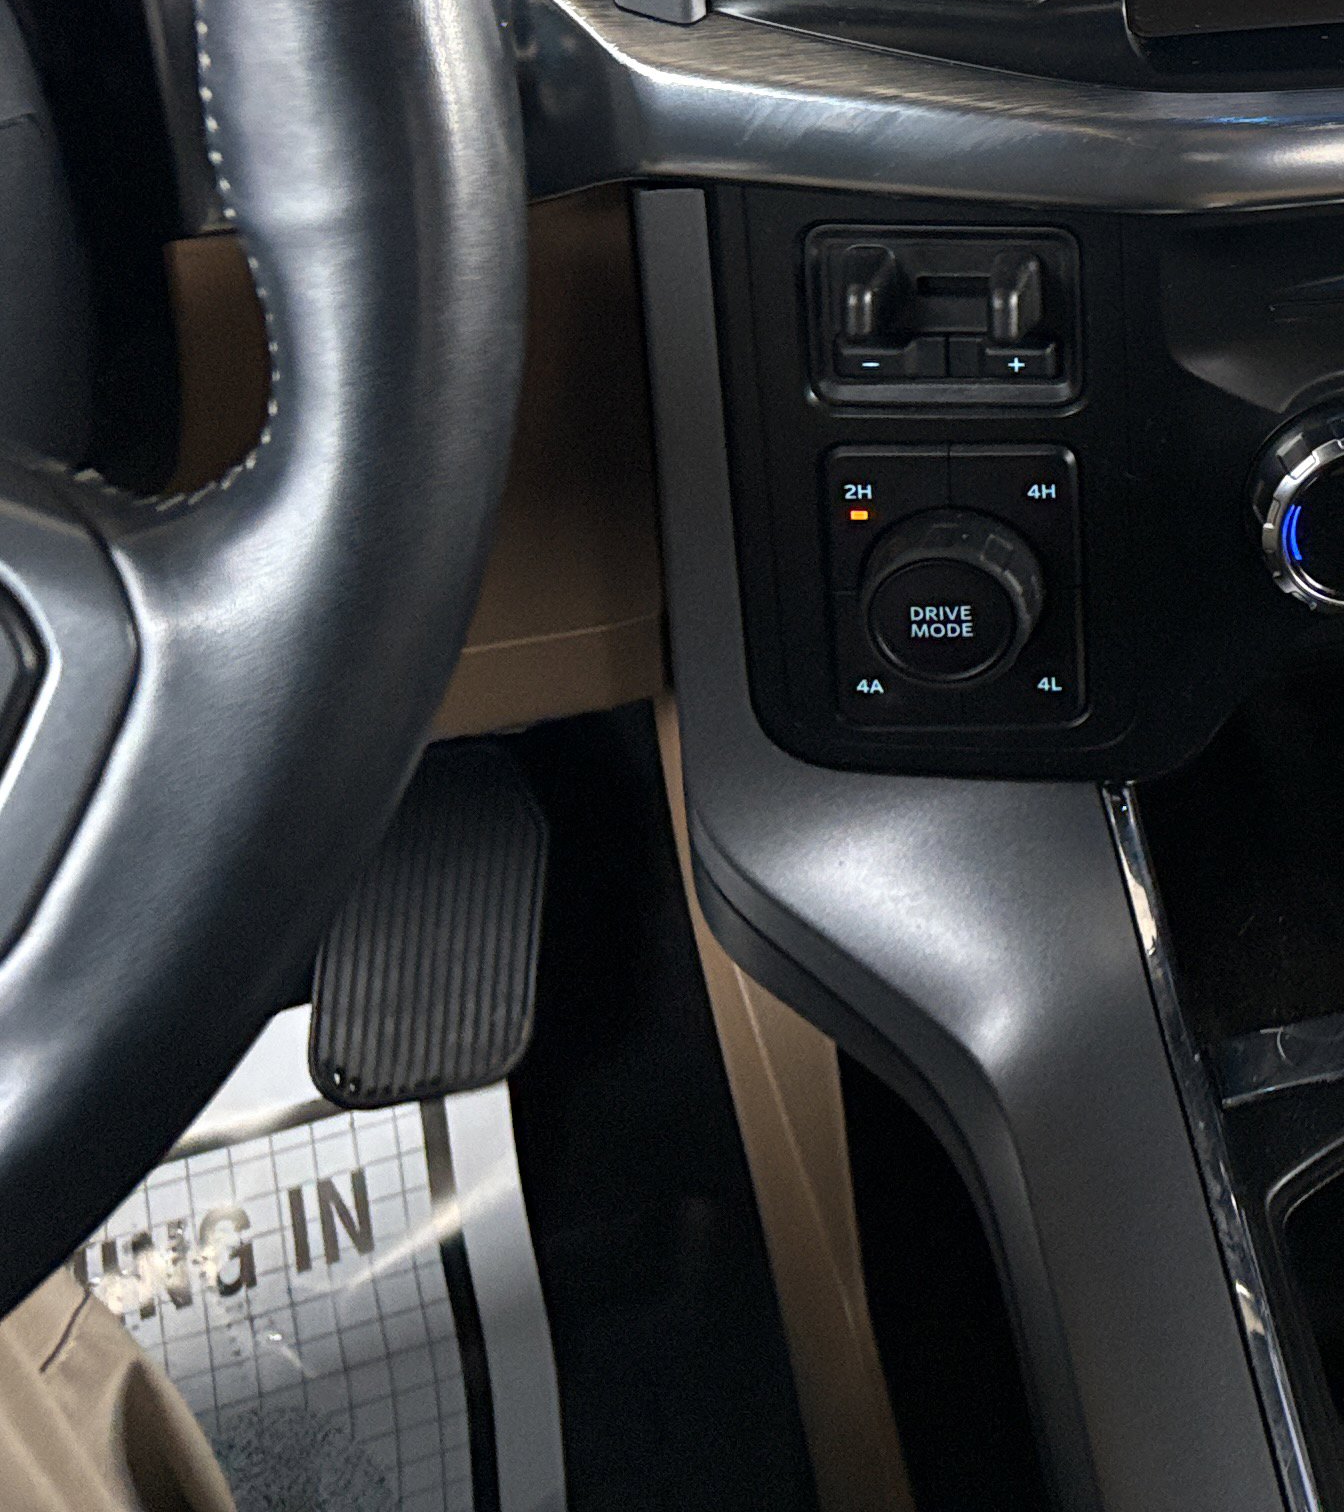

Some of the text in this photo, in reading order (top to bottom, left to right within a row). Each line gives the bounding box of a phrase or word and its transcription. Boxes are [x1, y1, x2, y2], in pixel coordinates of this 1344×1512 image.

[844, 484, 873, 500] 2H
[1027, 483, 1056, 499] 4H
[909, 604, 974, 622] DRIVE
[911, 622, 974, 638] MODE
[856, 679, 885, 694] 4A
[1037, 676, 1063, 692] 4L
[288, 1166, 376, 1274] IN
